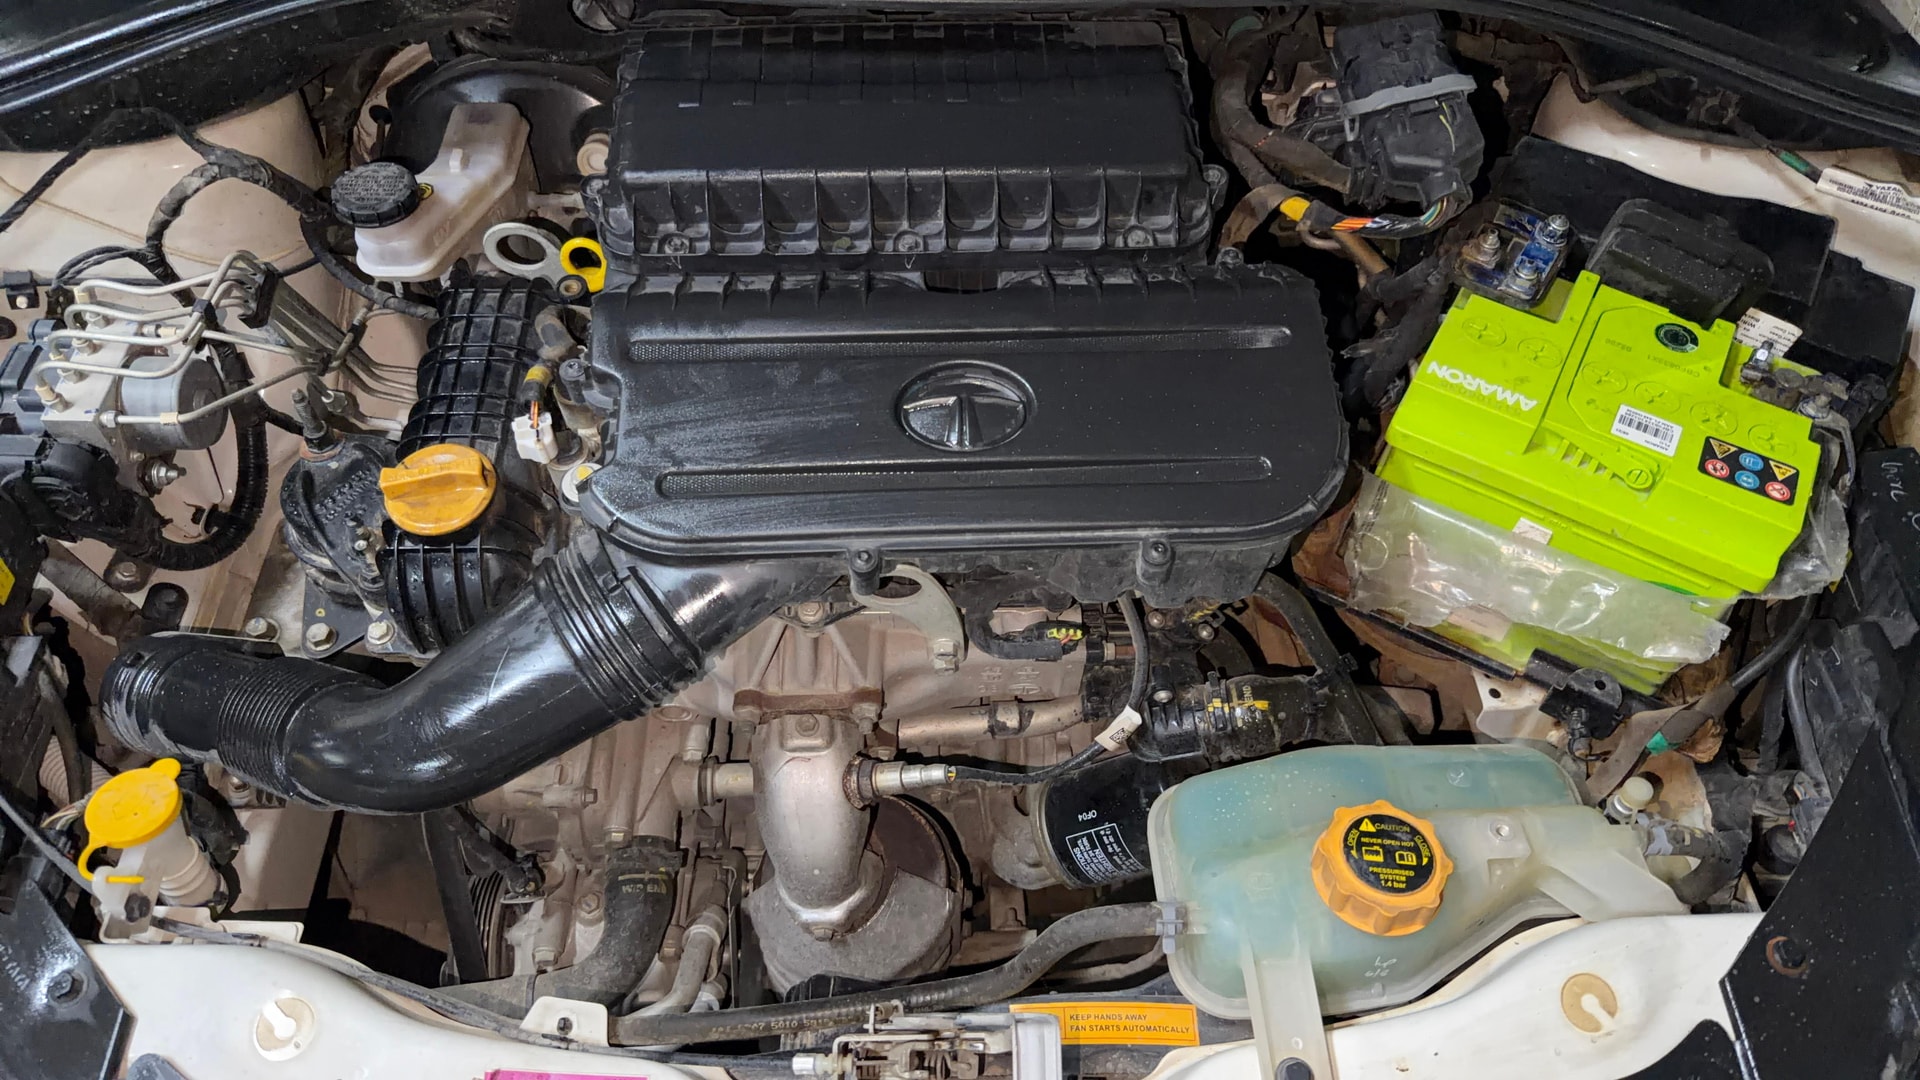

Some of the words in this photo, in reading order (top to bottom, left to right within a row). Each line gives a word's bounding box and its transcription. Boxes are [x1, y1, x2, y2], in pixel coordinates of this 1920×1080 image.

[1426, 361, 1538, 411] AMARON
[1078, 809, 1097, 822] OF04
[1374, 823, 1410, 833] CAUTION
[1347, 828, 1359, 847] OPEN
[1360, 837, 1382, 845] NEVER
[1383, 839, 1401, 847] OPEN
[1413, 834, 1431, 857] CLOSE
[1073, 846, 1101, 880] STRUCTIONS
[1369, 866, 1415, 877] PRESSURISED
[1379, 874, 1406, 882] SYSTEM
[1393, 881, 1406, 889] bar
[1123, 1025, 1190, 1034] AUTOMATICALLY
